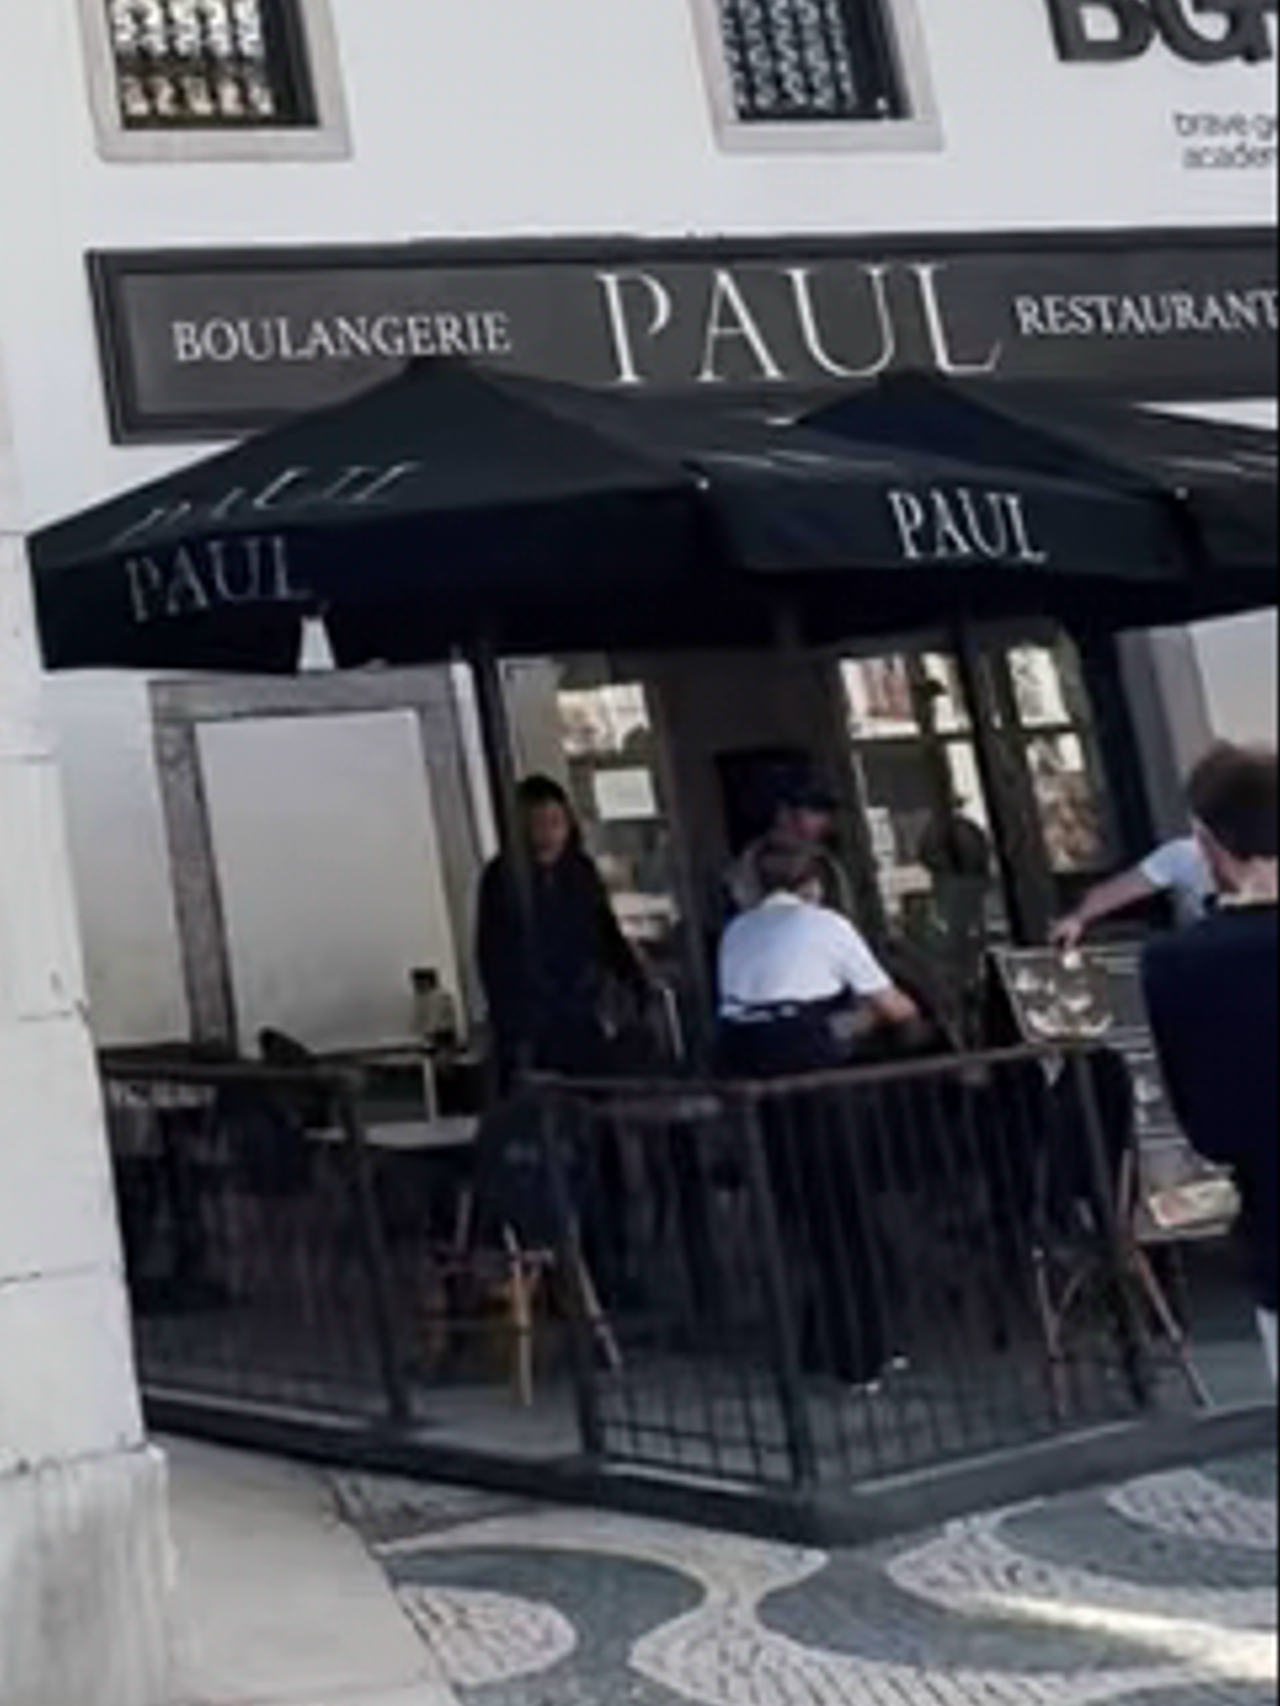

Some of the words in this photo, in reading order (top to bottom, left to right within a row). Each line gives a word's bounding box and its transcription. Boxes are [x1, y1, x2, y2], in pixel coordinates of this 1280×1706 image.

[1183, 142, 1278, 169] acade
[173, 312, 512, 362] BOULANGERIE
[595, 262, 1002, 384] PAUL
[1015, 290, 1278, 335] RESTAURANT
[890, 488, 1046, 563] PAUL
[125, 535, 314, 622] PAUL
